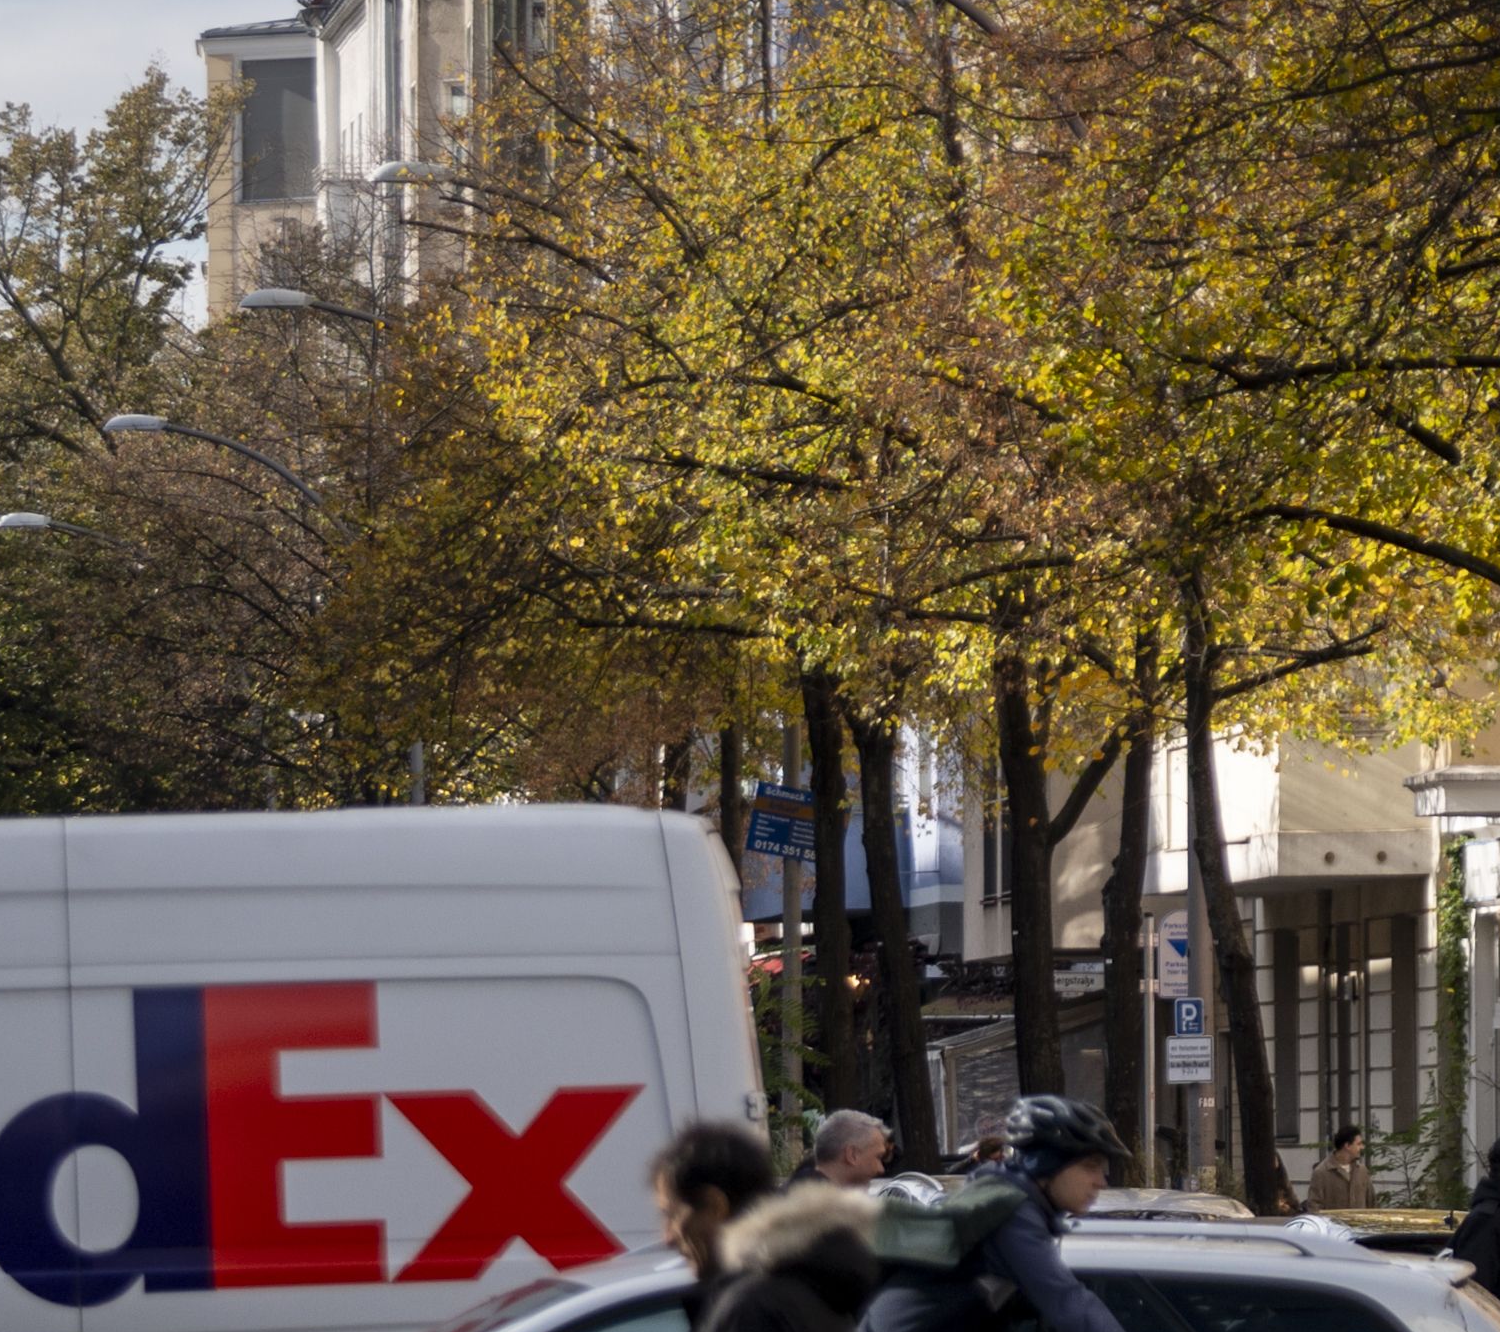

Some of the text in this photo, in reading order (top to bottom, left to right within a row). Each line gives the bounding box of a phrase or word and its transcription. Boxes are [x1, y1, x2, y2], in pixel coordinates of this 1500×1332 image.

[755, 839, 781, 853] 0174
[781, 844, 801, 857] 351
[1052, 974, 1096, 987] ergstraße
